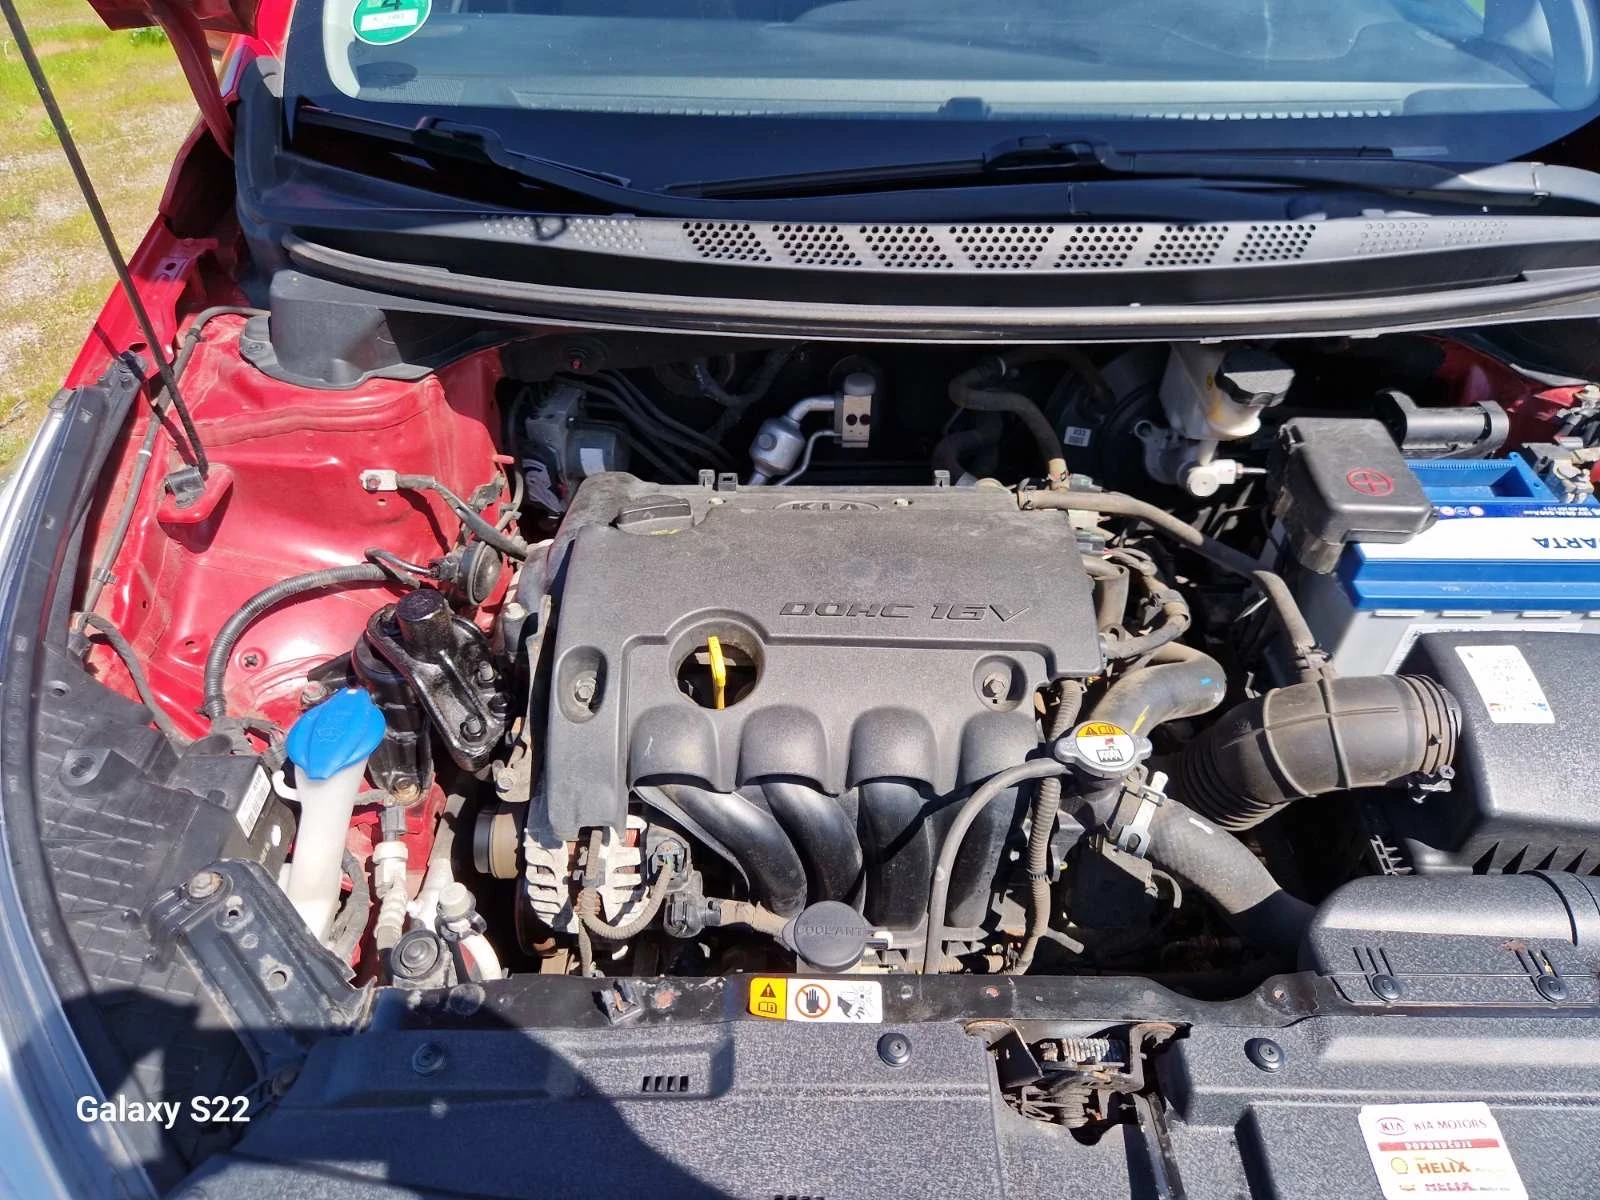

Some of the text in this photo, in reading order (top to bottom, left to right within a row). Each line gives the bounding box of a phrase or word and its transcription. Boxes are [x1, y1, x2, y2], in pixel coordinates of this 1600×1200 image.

[1532, 537, 1600, 549] ARTA
[779, 602, 1030, 622] DOHC 16V
[797, 926, 863, 937] COOLANT
[1381, 1118, 1488, 1132] KIA KIA MOTORS
[1416, 1161, 1472, 1174] HELIX
